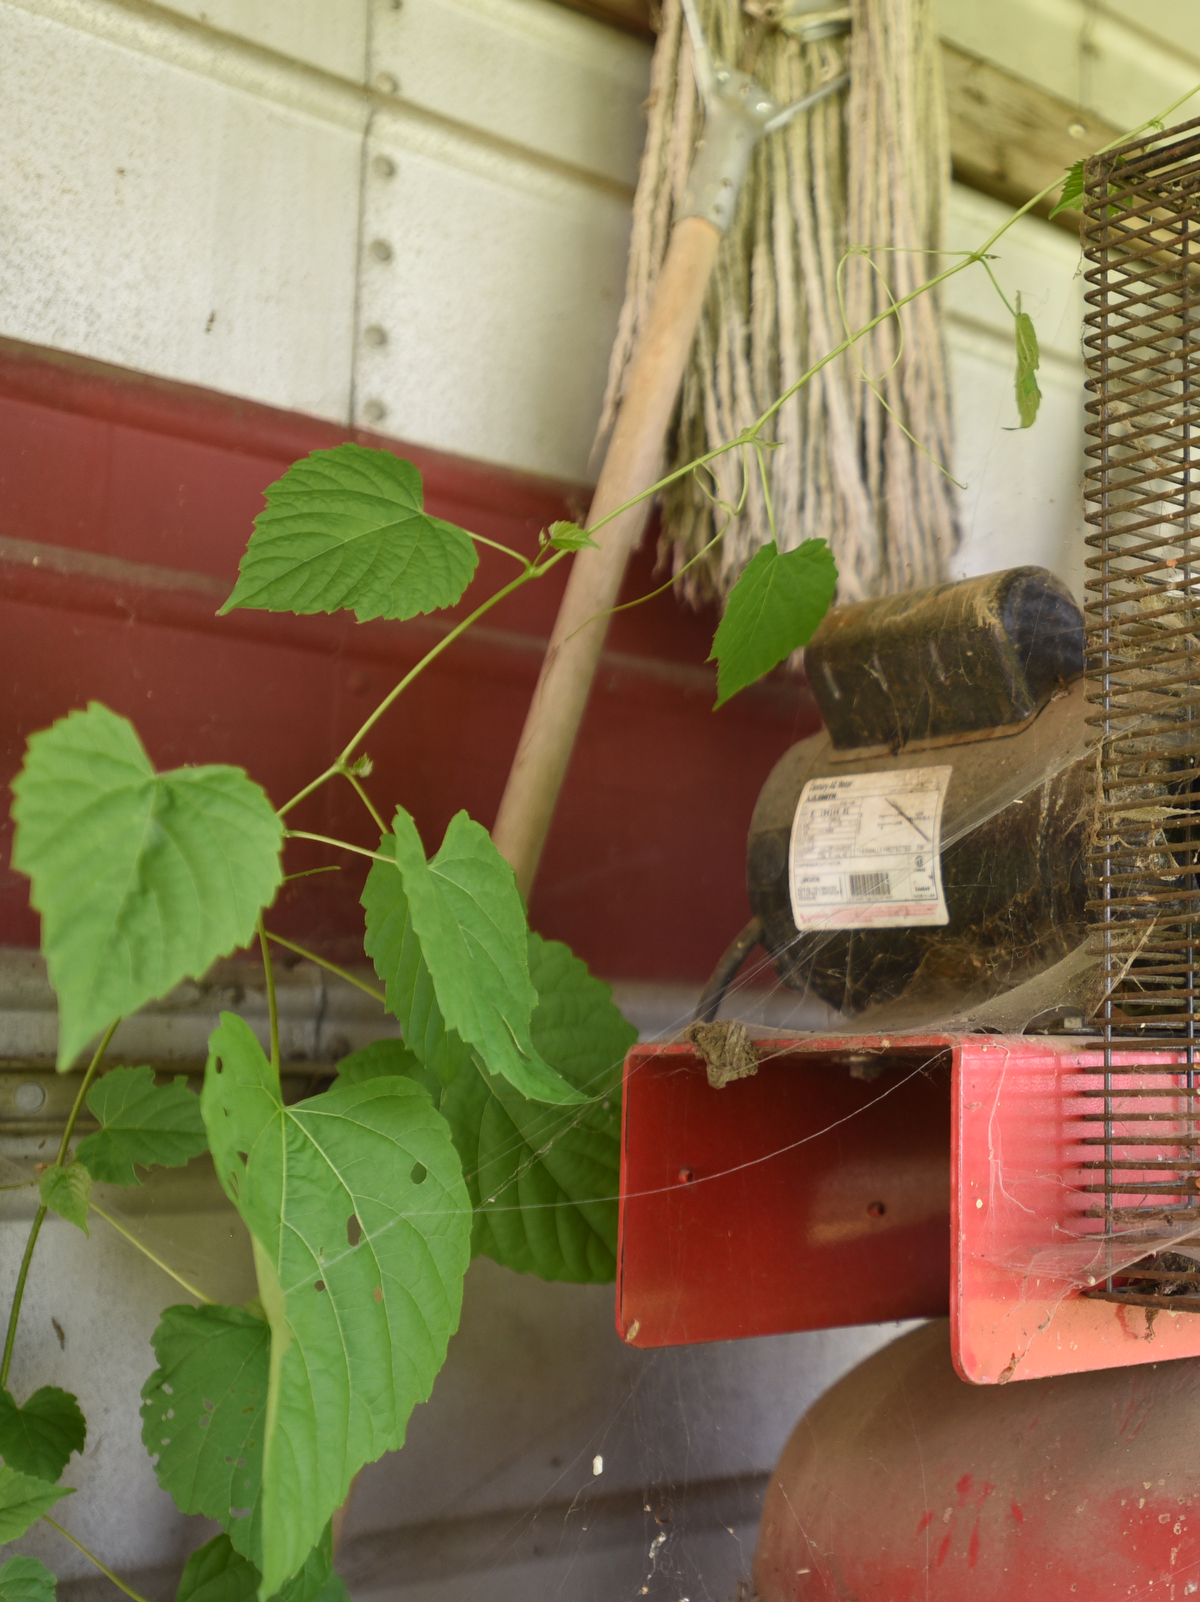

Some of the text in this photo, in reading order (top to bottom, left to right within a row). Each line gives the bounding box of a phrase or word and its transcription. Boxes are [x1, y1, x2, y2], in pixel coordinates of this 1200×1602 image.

[829, 781, 838, 789] AC
[838, 780, 853, 788] Motor
[883, 844, 911, 853] PROTECTED
